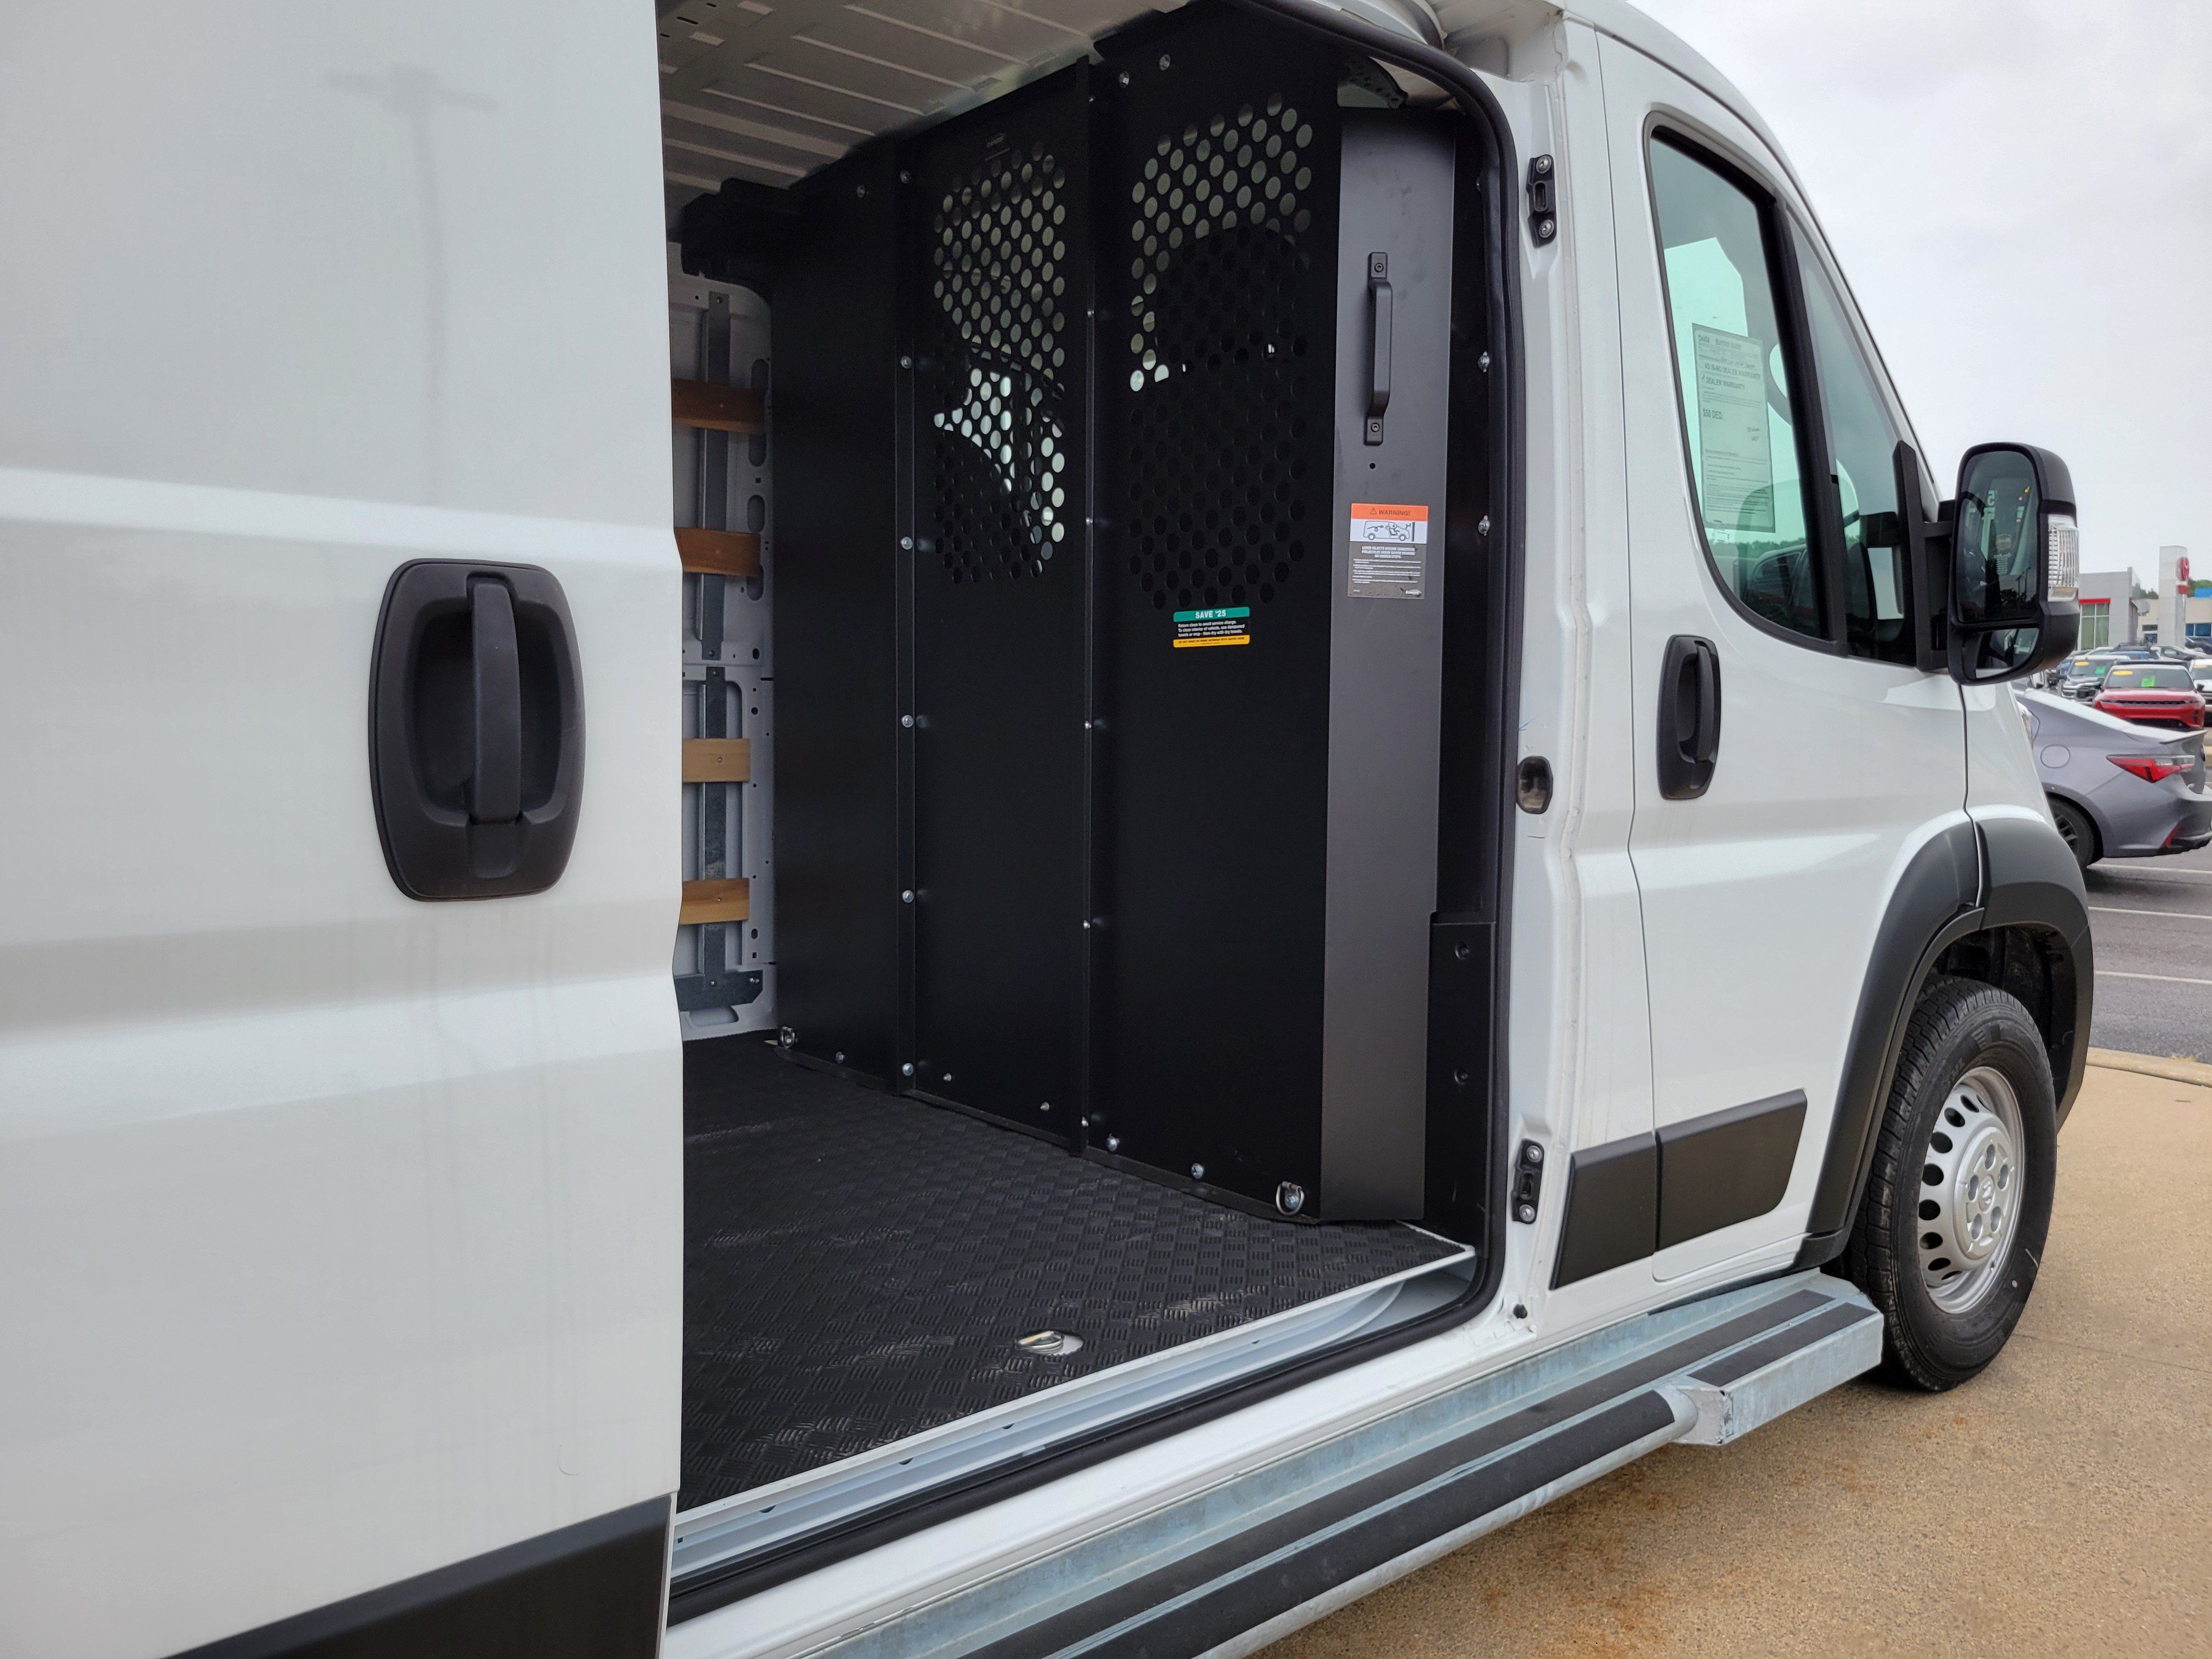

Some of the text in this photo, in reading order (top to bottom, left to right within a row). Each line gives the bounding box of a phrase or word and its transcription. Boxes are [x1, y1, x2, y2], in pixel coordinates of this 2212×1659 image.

[1722, 366, 1737, 375] DEALER
[1739, 370, 1760, 380] WARRANTY
[1706, 377, 1722, 386] DEALER
[1723, 380, 1745, 390] WARRANTY
[1702, 408, 1711, 417] $50
[1195, 610, 1214, 619] SAVE
